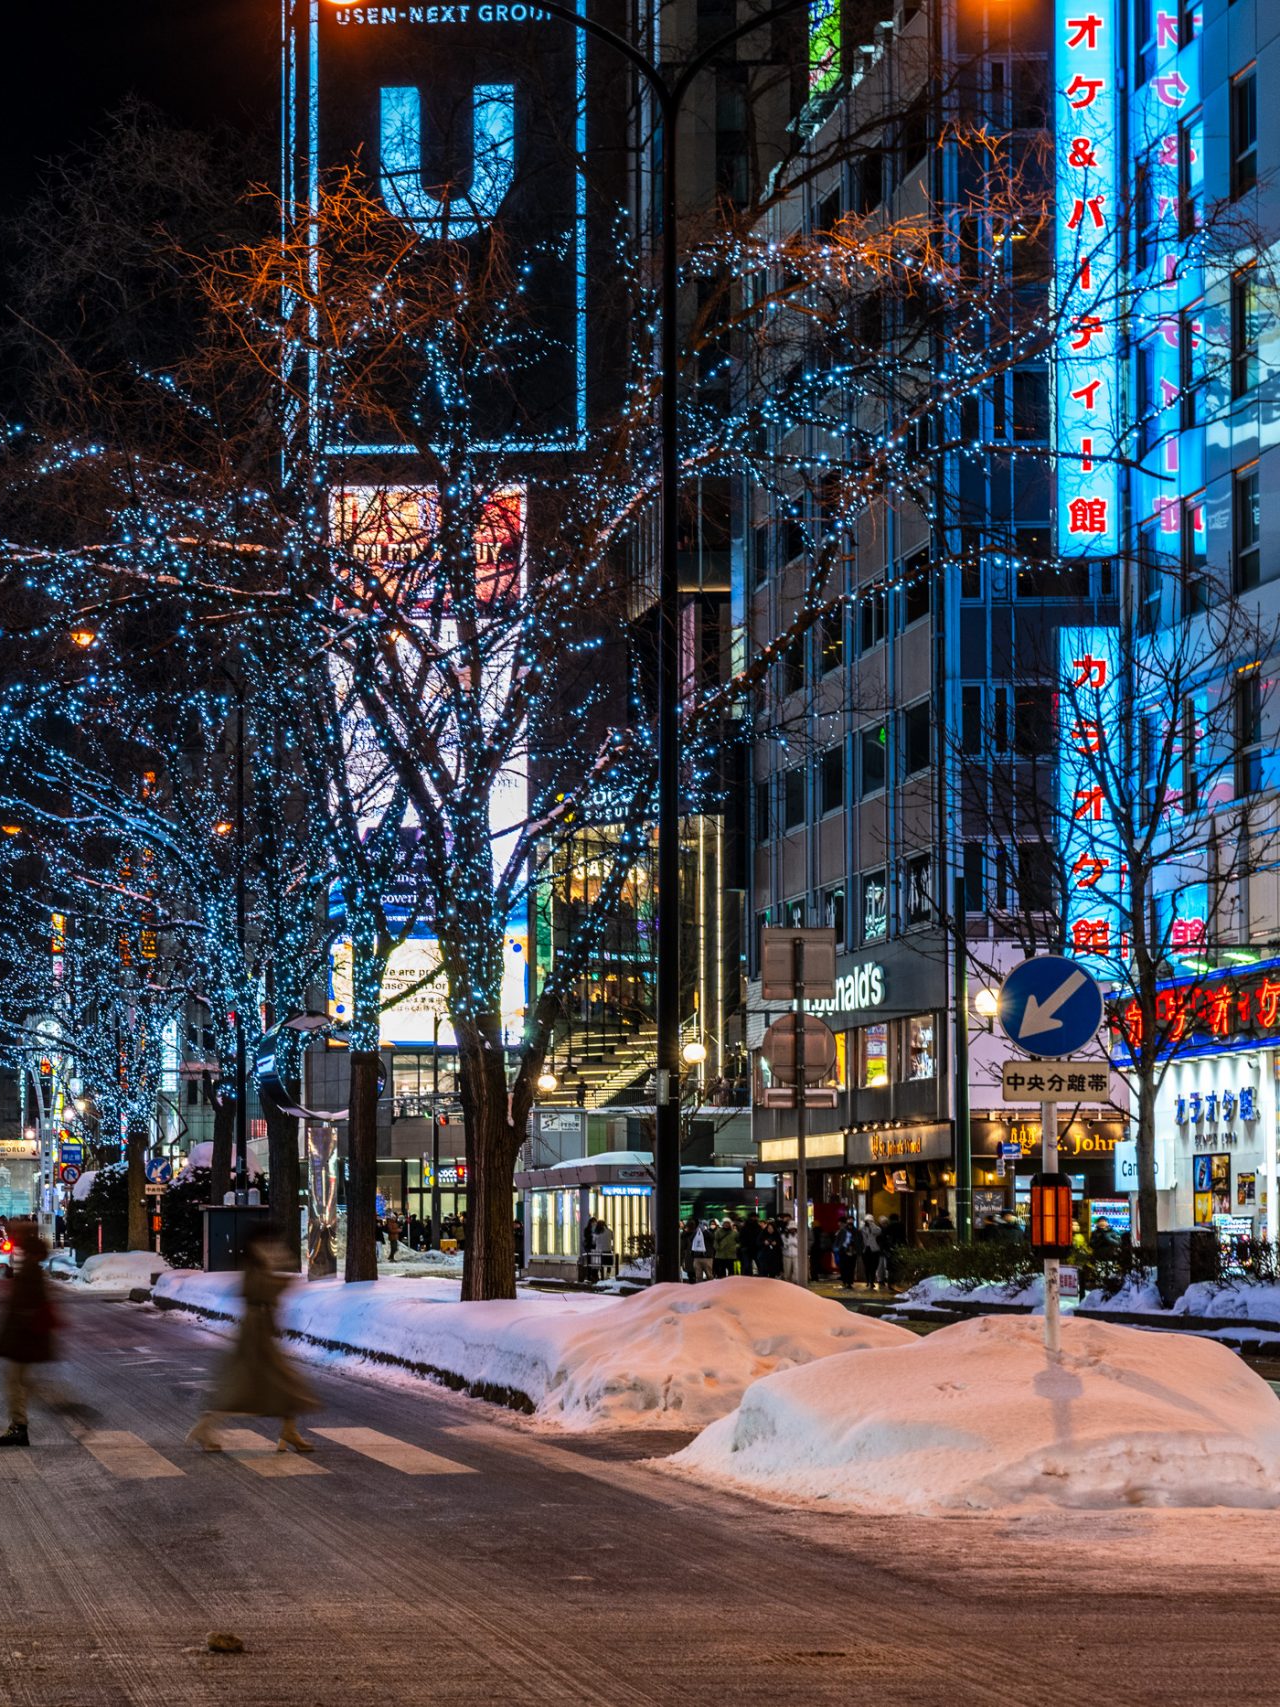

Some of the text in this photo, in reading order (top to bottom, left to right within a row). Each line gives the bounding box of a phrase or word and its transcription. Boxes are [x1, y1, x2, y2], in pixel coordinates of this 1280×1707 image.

[1006, 1072, 1108, 1093] 中央分離帯
